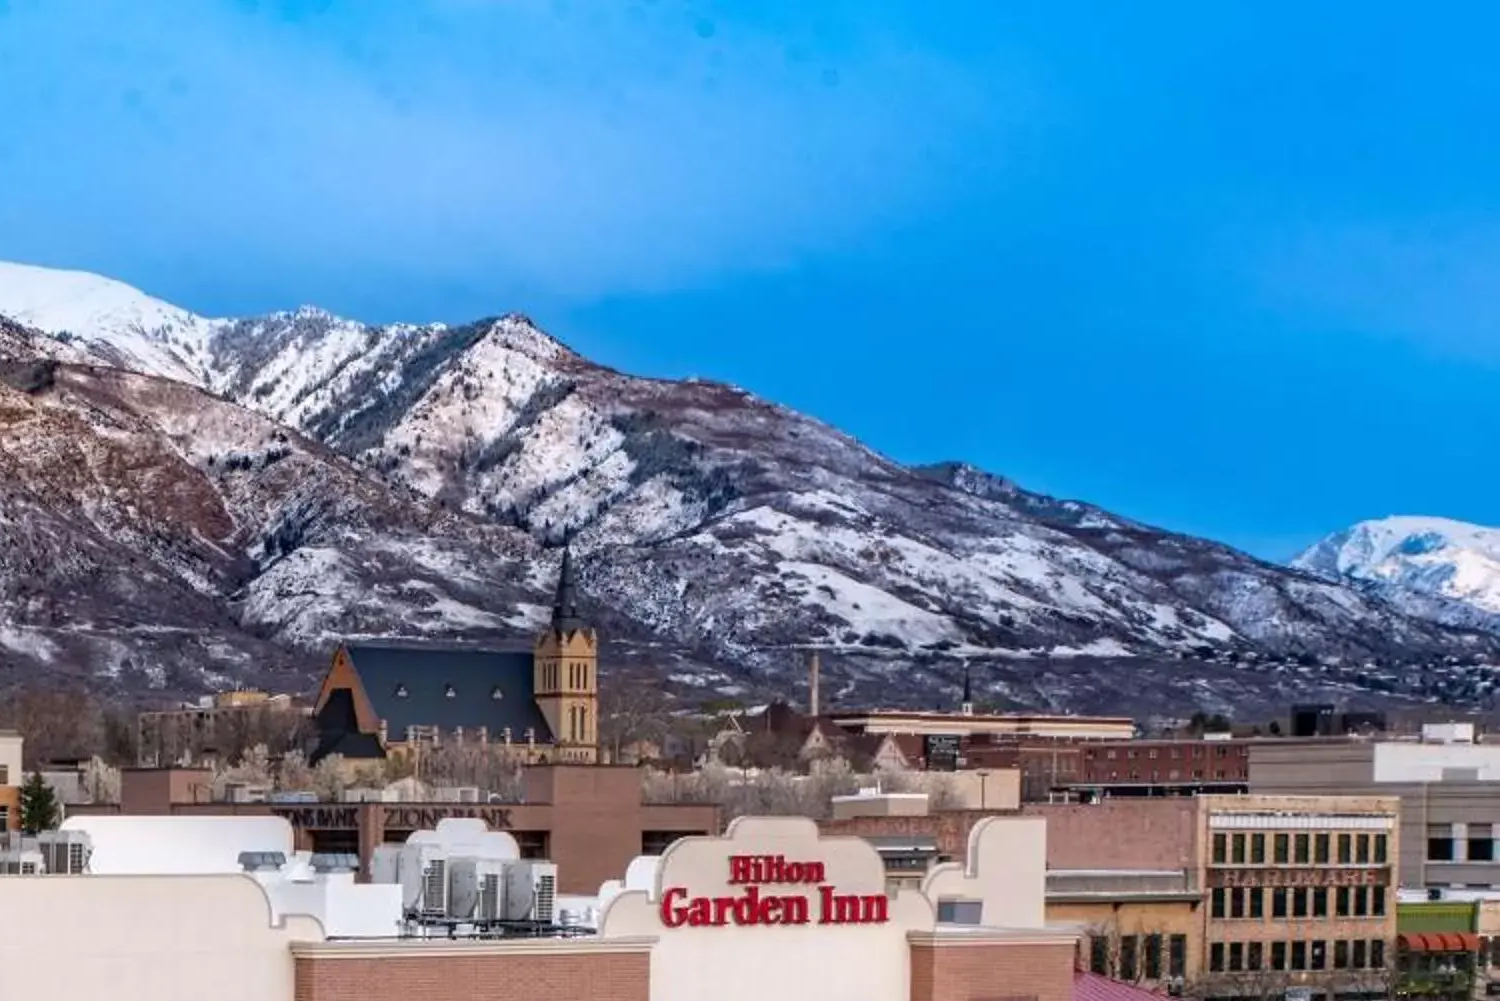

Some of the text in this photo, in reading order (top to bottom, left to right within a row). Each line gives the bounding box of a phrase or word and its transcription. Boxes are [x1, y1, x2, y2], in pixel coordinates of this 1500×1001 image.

[727, 855, 825, 884] Hilton
[660, 886, 889, 928] Garden Inn
